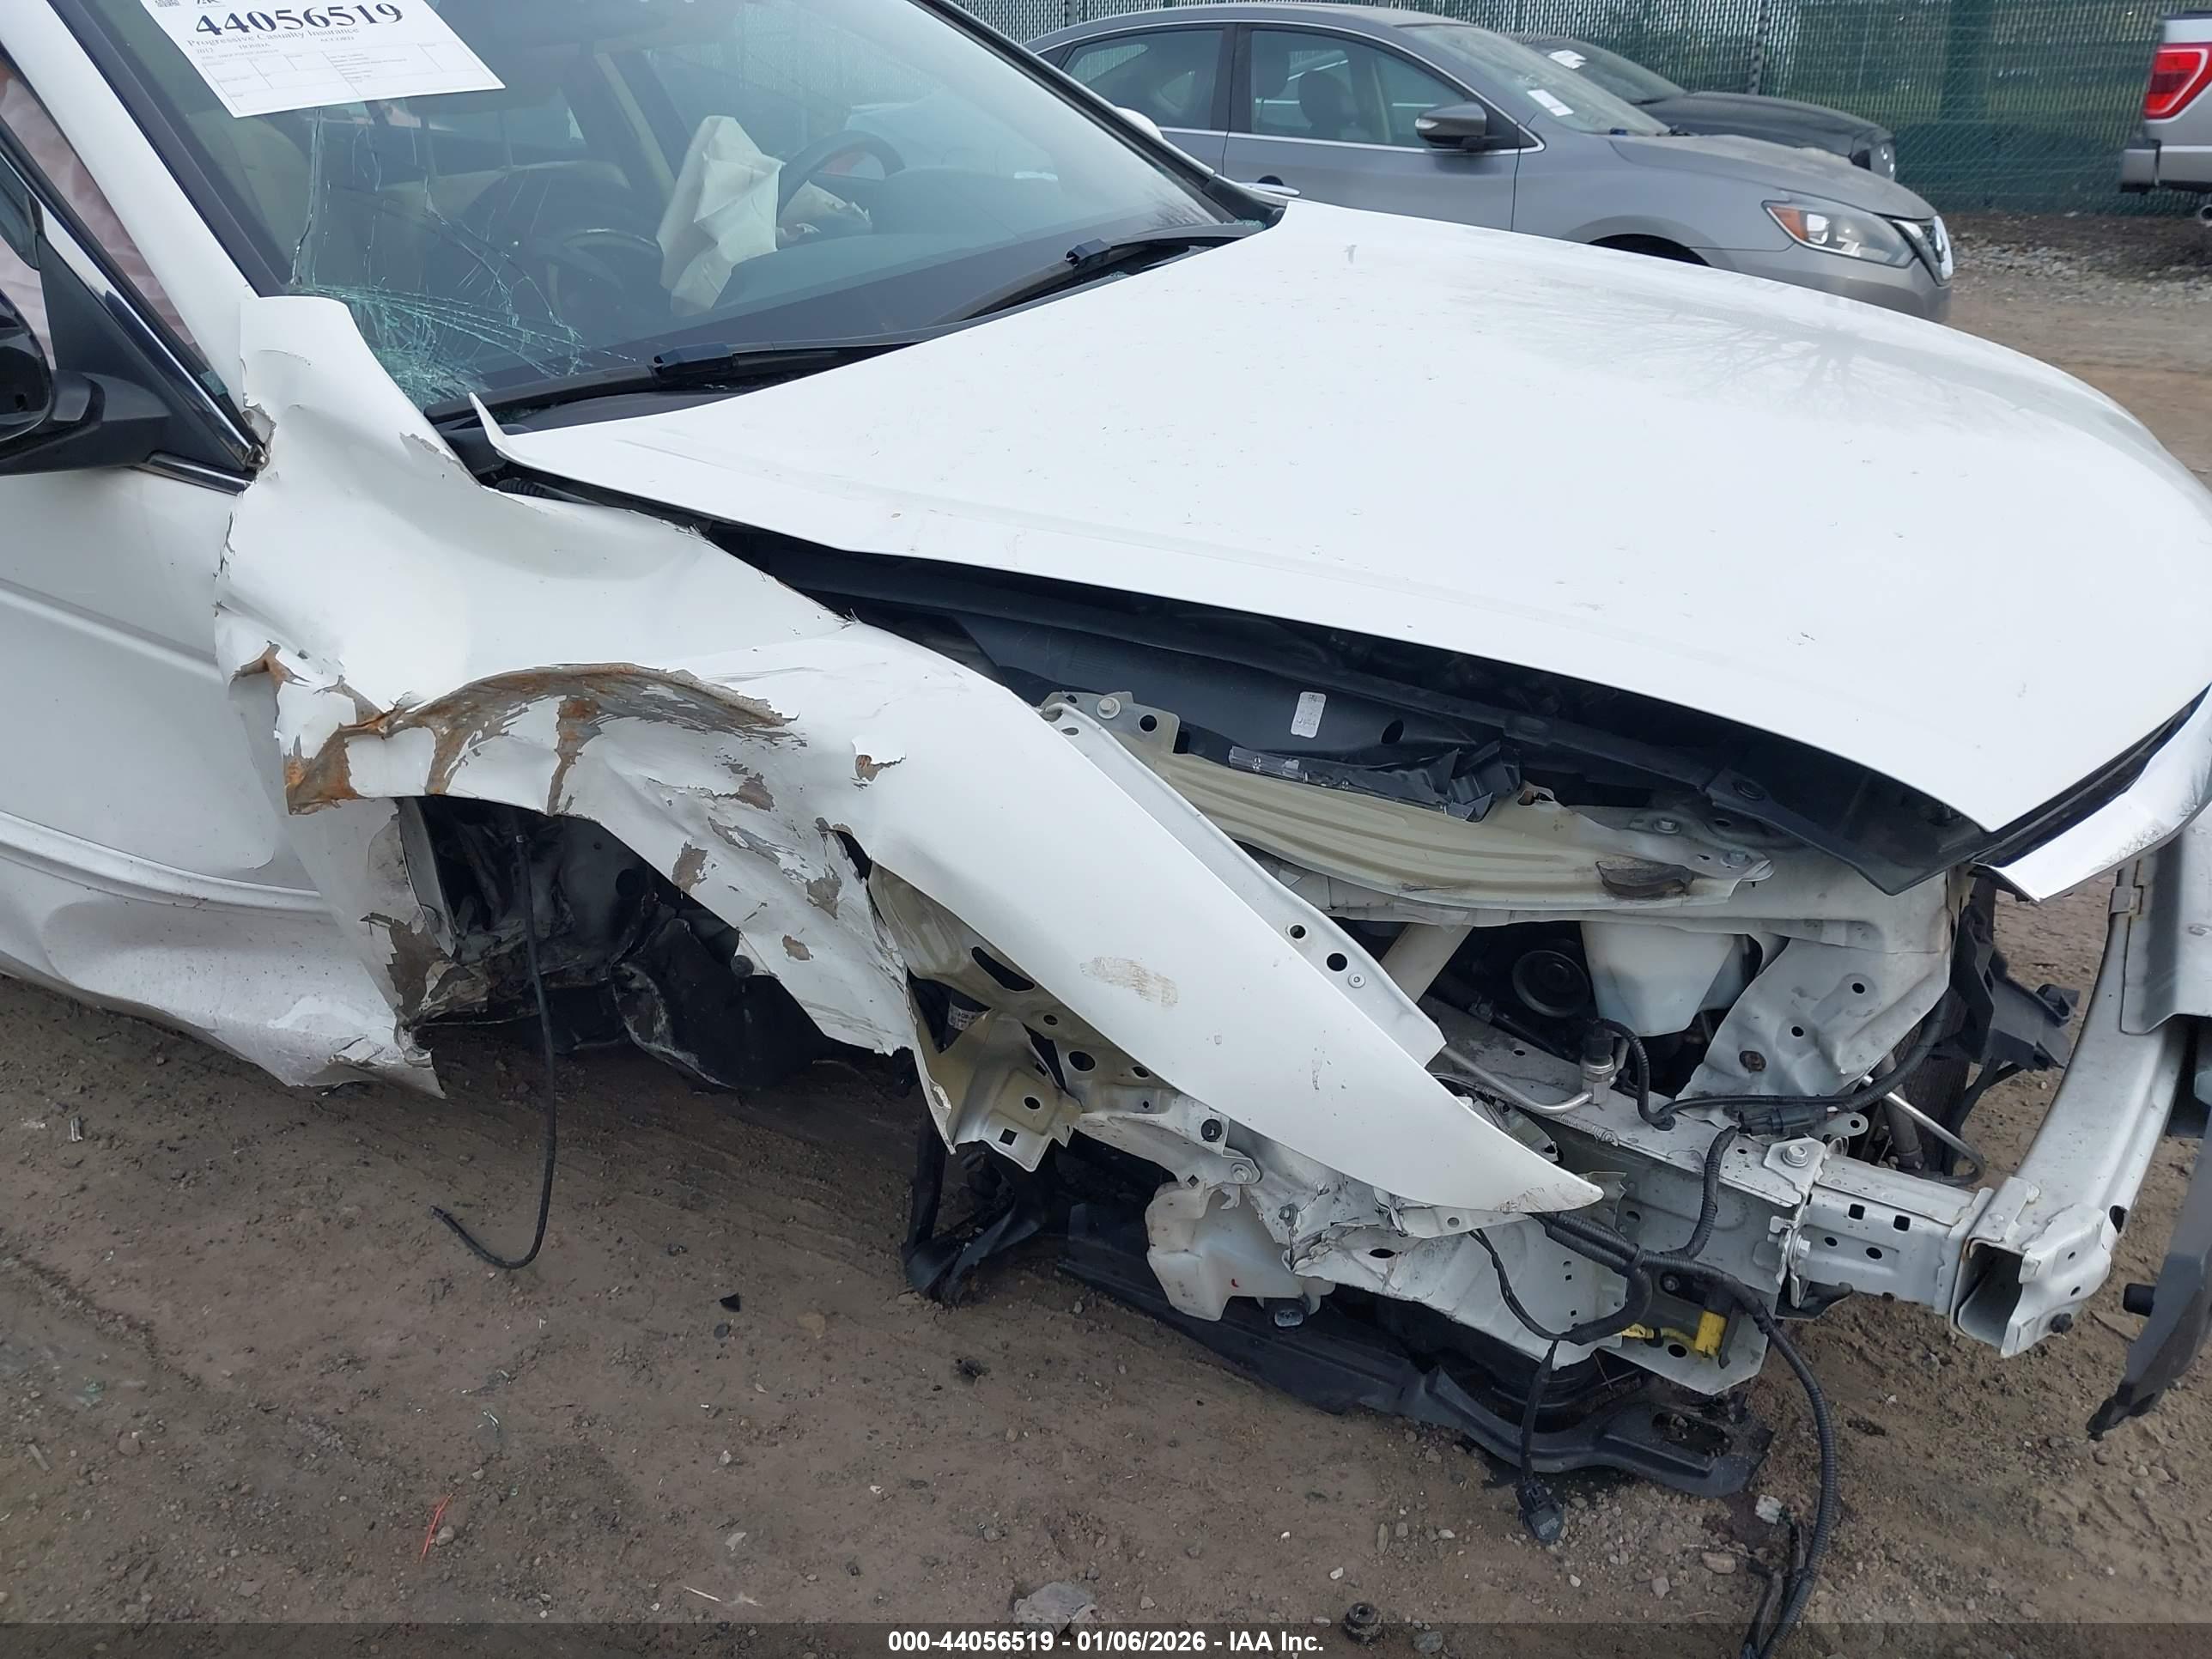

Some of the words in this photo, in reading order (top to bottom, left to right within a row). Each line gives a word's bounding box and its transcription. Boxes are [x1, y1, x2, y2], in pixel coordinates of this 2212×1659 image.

[196, 2, 404, 36] 44056519
[186, 35, 254, 47] Progressive
[257, 31, 304, 41] Casualty
[307, 27, 360, 38] Insurance
